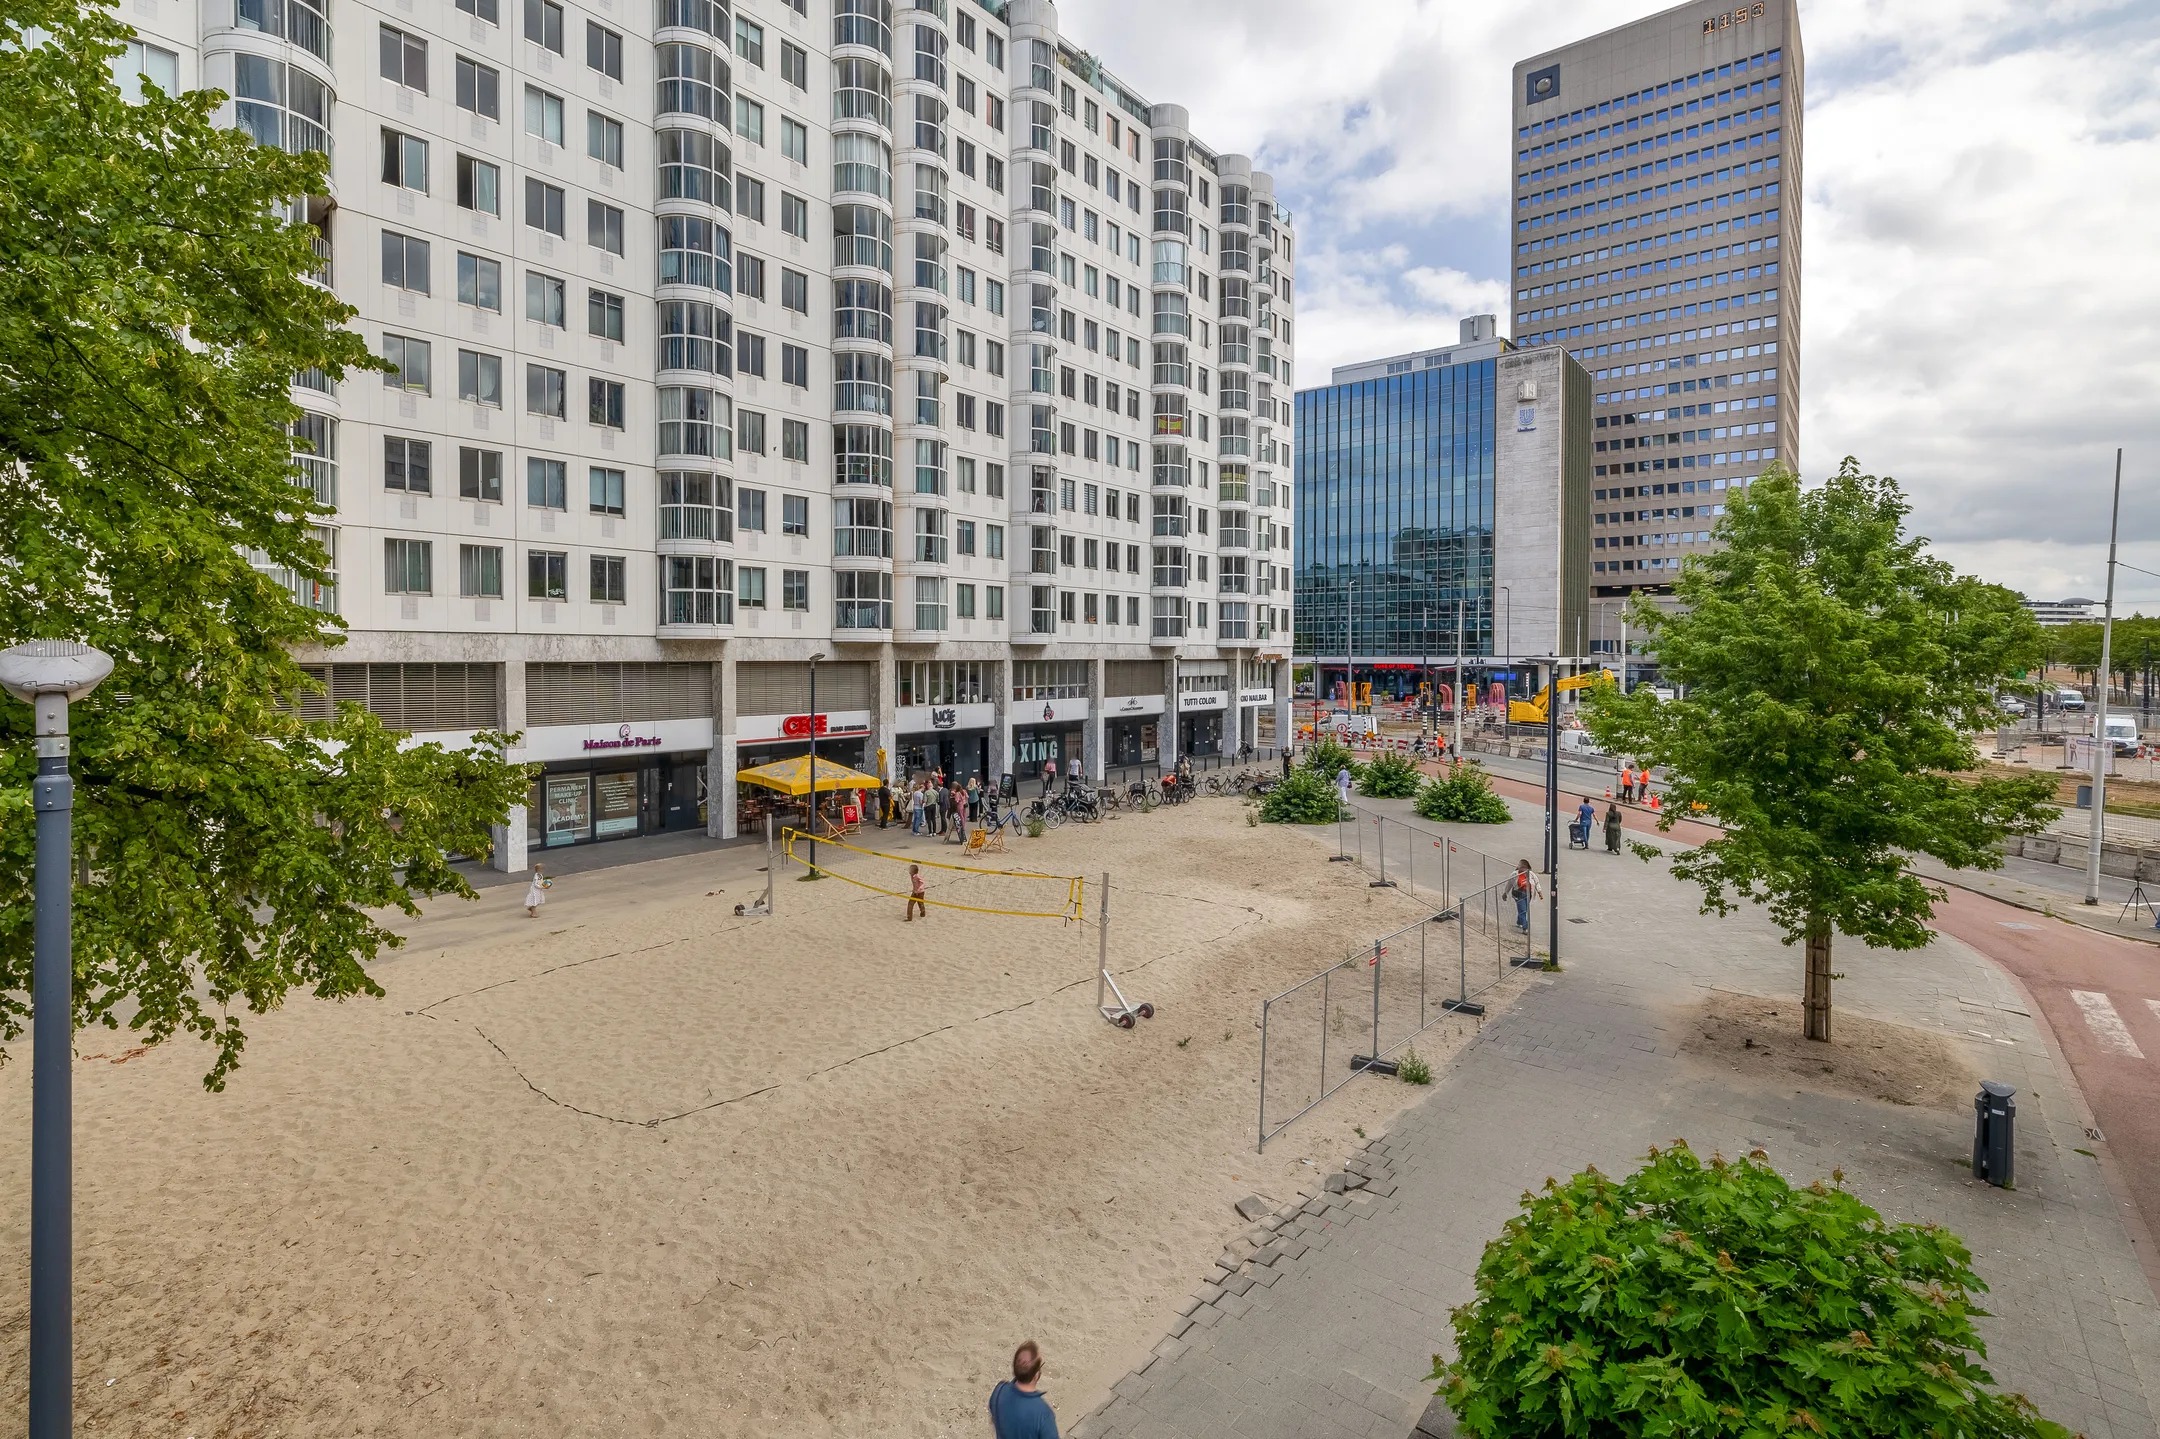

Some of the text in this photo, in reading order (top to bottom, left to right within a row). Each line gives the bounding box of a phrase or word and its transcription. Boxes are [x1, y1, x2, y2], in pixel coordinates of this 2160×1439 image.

[1184, 696, 1217, 707] TUTTI COLORI
[583, 736, 662, 750] Maison de Paris
[549, 784, 587, 793] PERMANENT
[554, 790, 582, 798] MAKE-UP
[552, 813, 585, 823] ACADEMY
